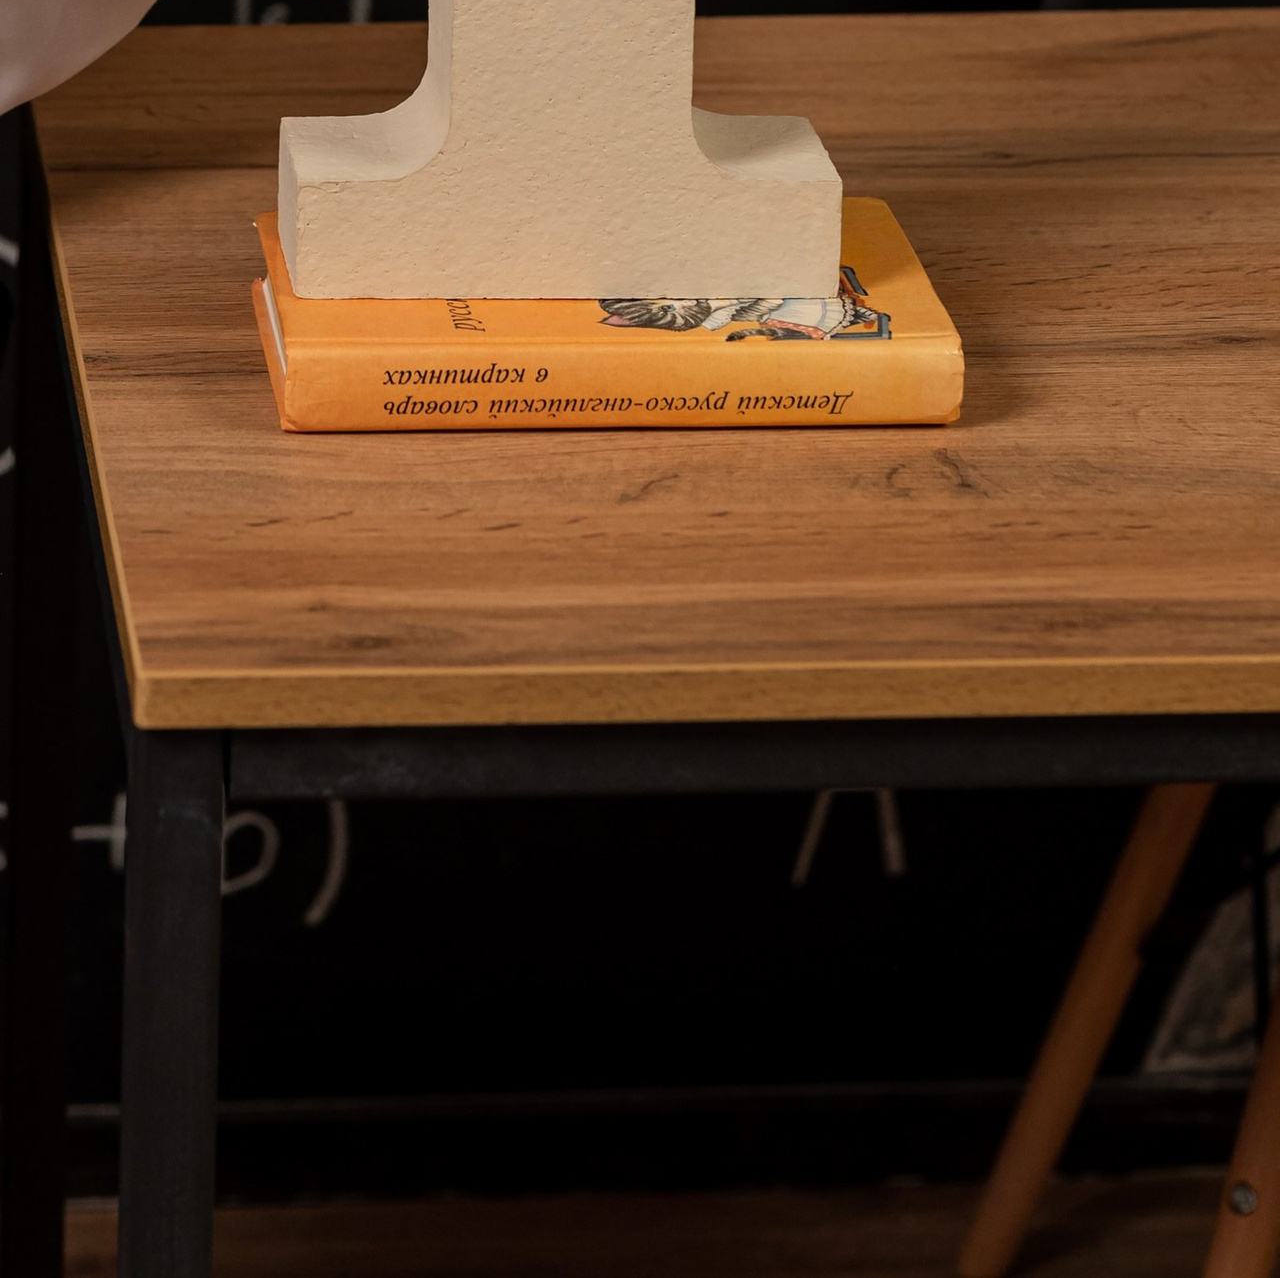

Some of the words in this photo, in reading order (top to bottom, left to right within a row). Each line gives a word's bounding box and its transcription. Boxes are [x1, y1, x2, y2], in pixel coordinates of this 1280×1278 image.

[383, 363, 525, 385] картинках
[535, 367, 549, 383] в
[383, 396, 479, 415] словарь
[489, 391, 730, 419] русско-английский
[737, 391, 854, 415] Детский
